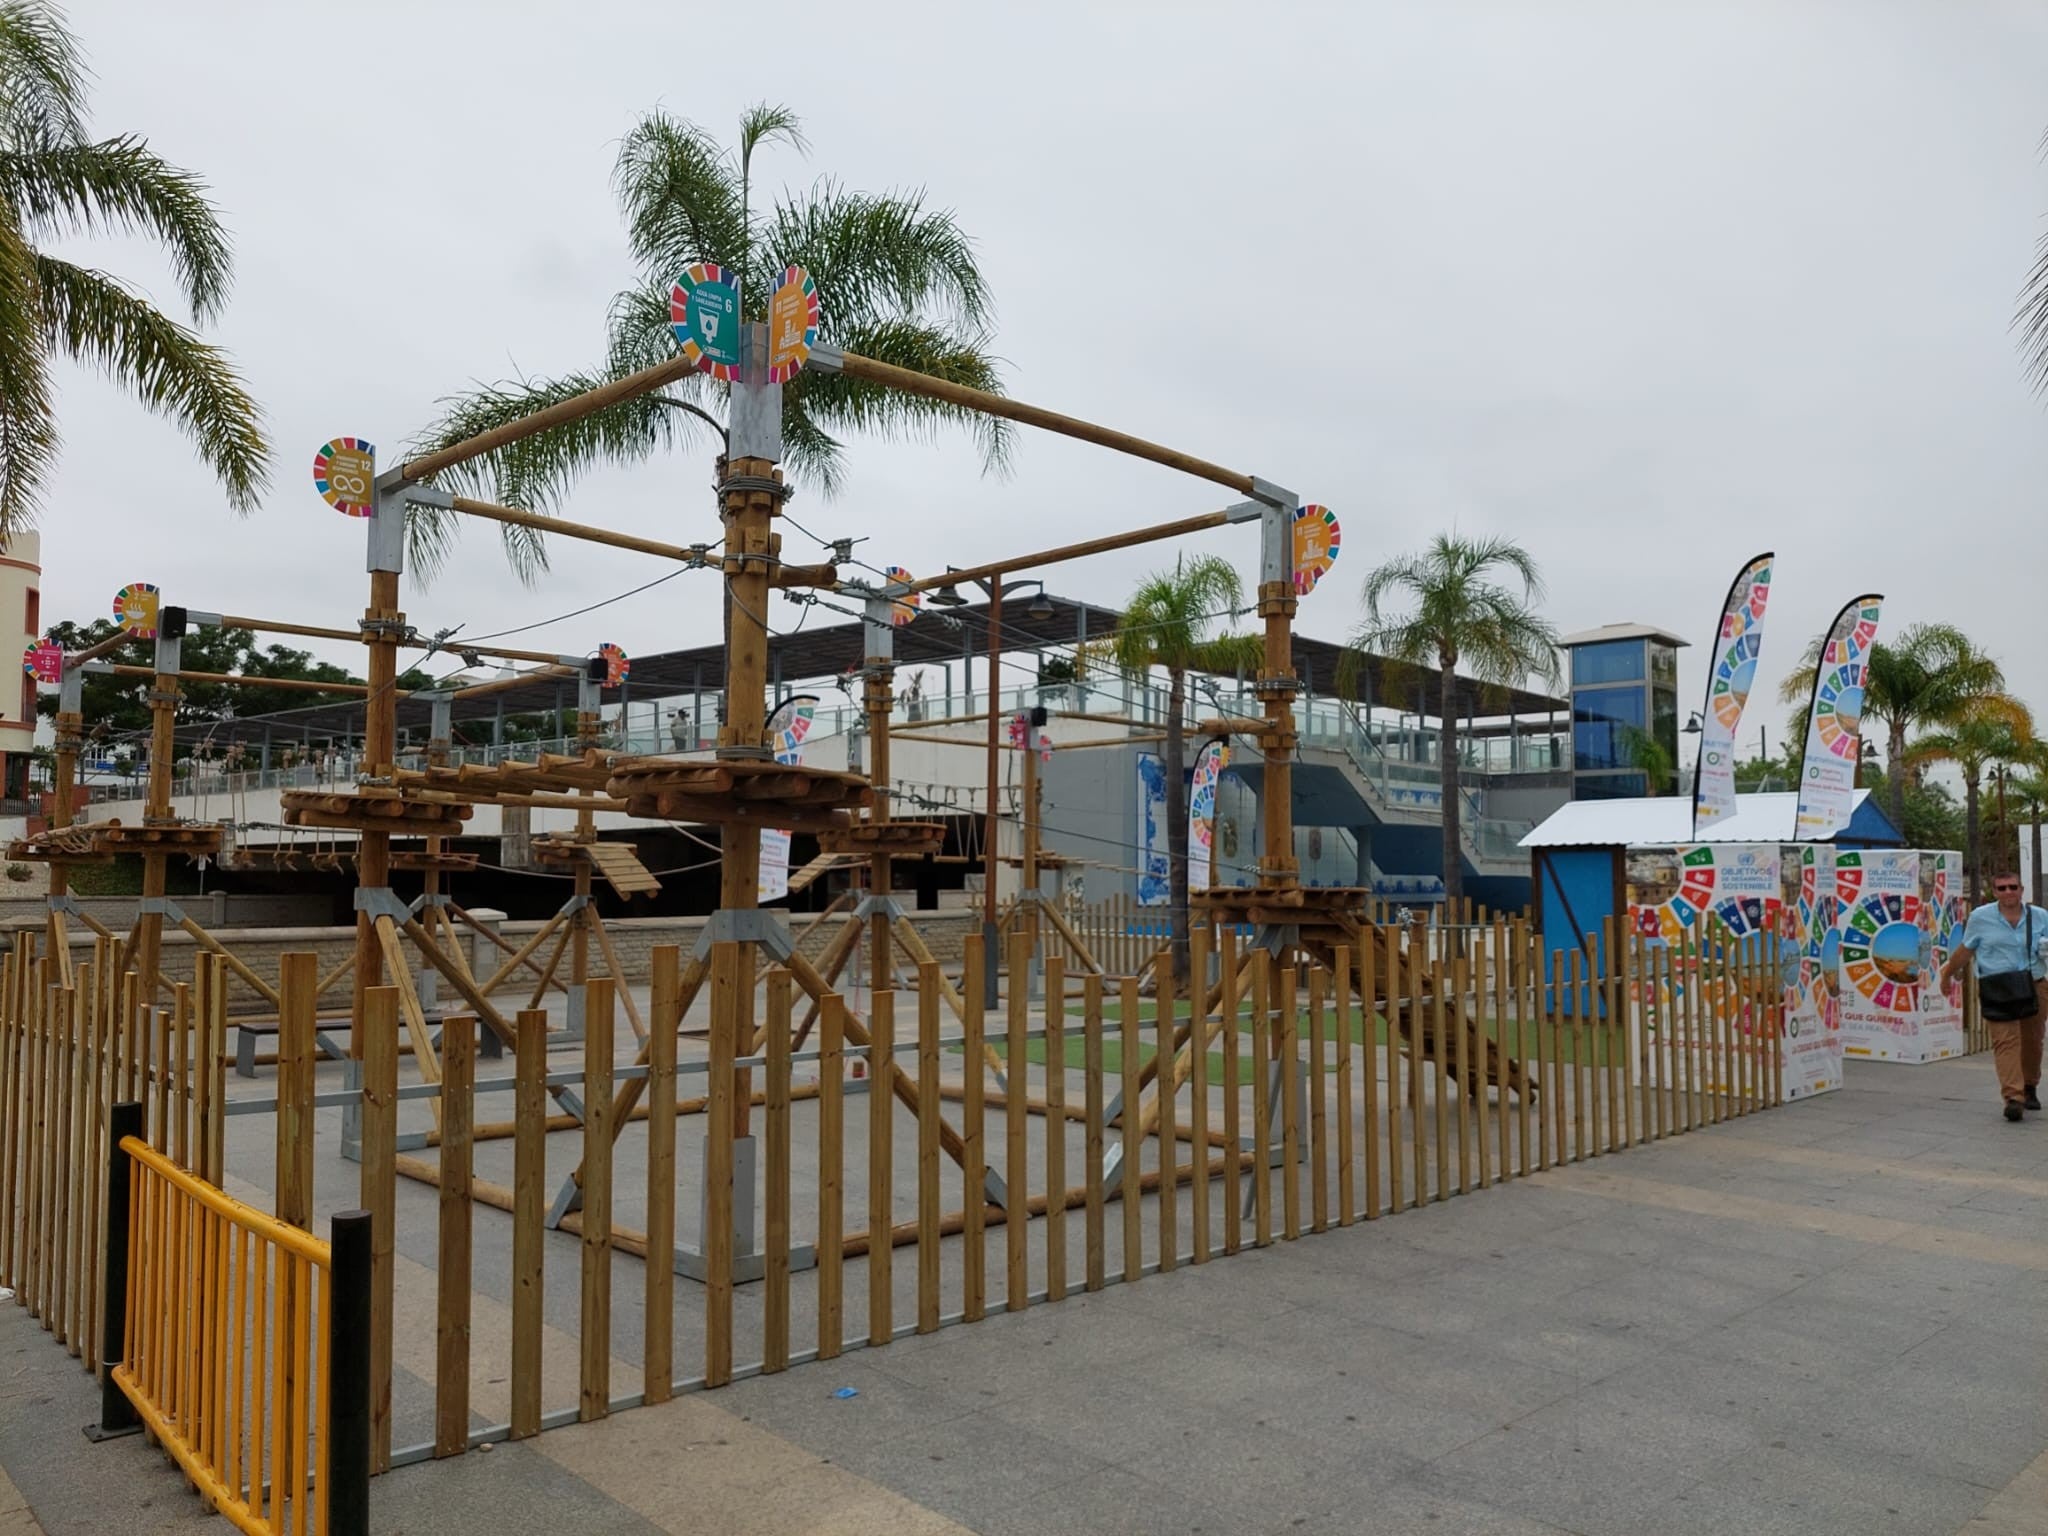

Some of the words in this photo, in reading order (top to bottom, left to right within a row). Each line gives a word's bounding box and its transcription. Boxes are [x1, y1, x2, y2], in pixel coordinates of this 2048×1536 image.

[725, 298, 732, 313] 6
[360, 460, 371, 471] 12
[1721, 867, 1773, 876] OBJETIVOS
[1867, 869, 1913, 877] OBJETIVOS
[1722, 882, 1773, 890] SOSTENIBLE
[1844, 1012, 1864, 1022] QUE
[1865, 1014, 1905, 1025] QUIERES
